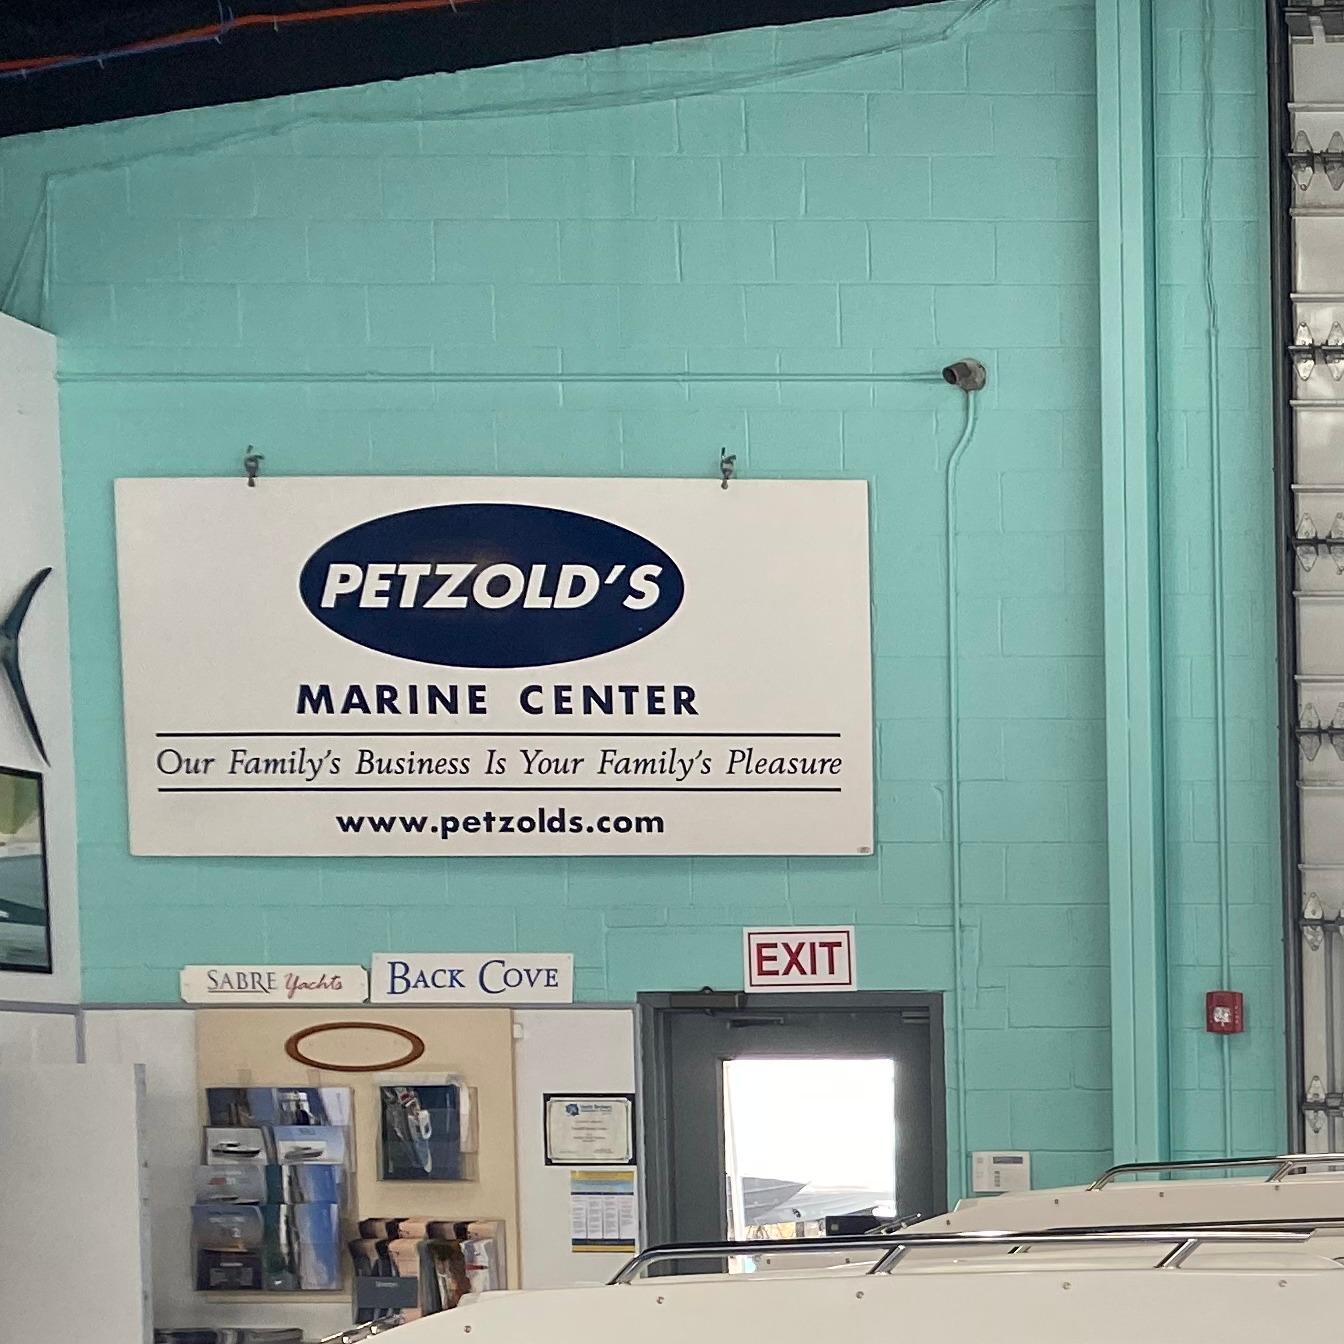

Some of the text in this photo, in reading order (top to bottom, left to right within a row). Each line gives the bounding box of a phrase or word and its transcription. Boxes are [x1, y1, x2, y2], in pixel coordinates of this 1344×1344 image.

[319, 563, 664, 611] PETZOLD'S
[296, 684, 700, 716] MARINE CENTER
[156, 747, 842, 782] Our Family's Business Is Your Family's Pleasure
[335, 807, 665, 841] www.petzolds.com
[756, 941, 843, 977] EXIT
[207, 970, 344, 999] SABRE Yachts
